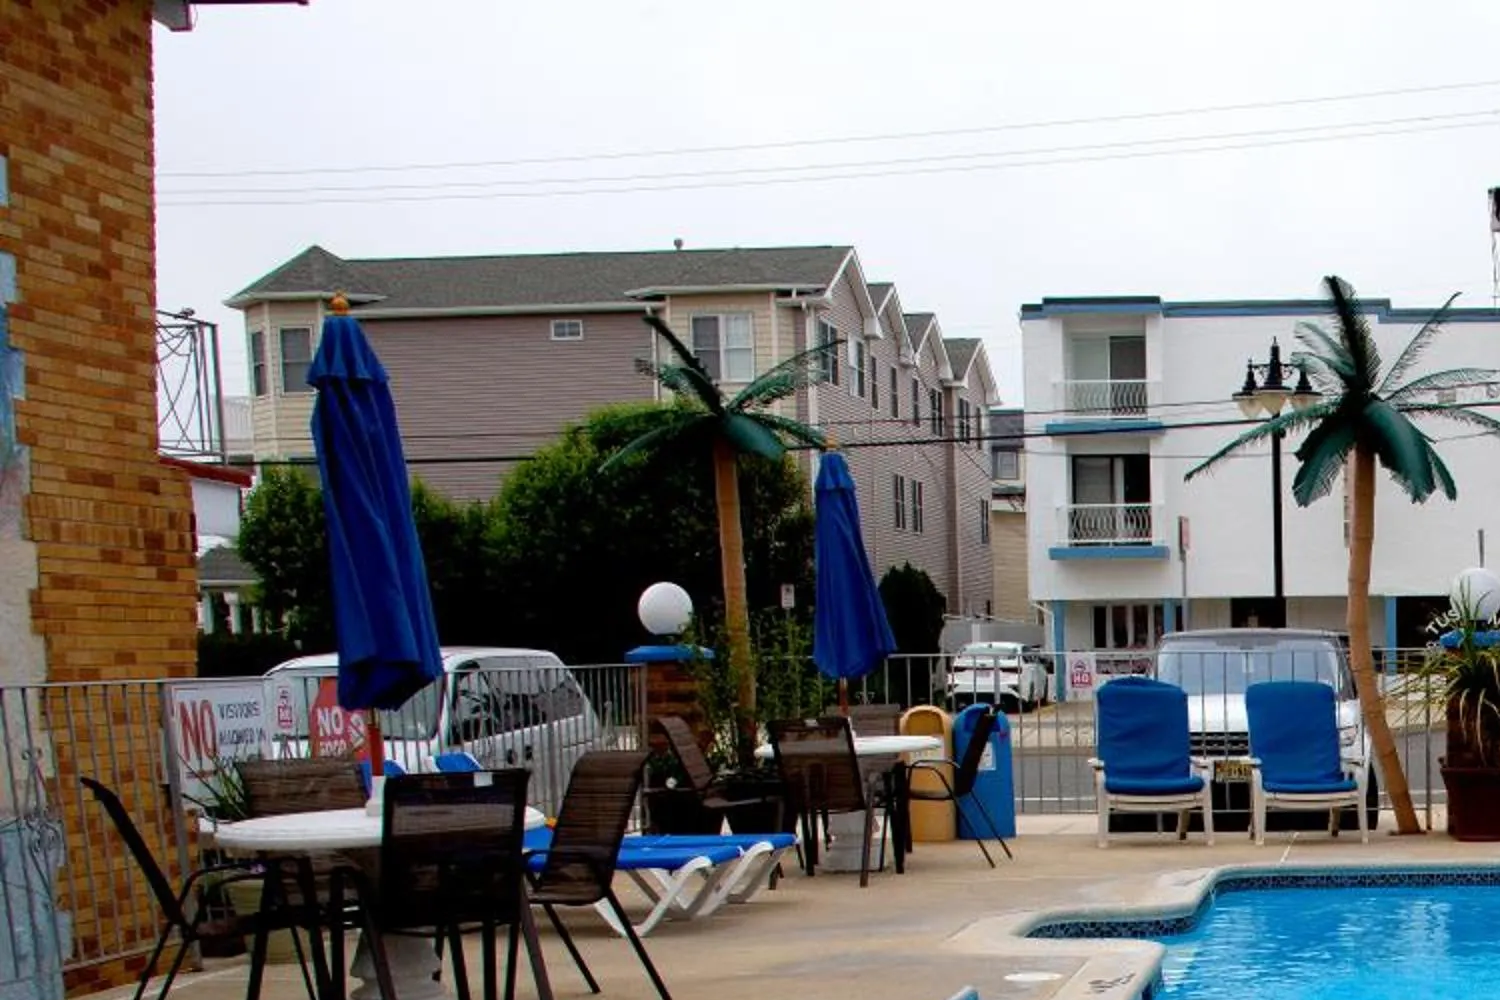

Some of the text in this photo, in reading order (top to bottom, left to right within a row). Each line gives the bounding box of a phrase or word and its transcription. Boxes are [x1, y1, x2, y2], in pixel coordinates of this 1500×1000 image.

[217, 701, 261, 720] VISITORS
[317, 706, 344, 737] NO
[180, 700, 217, 761] NO
